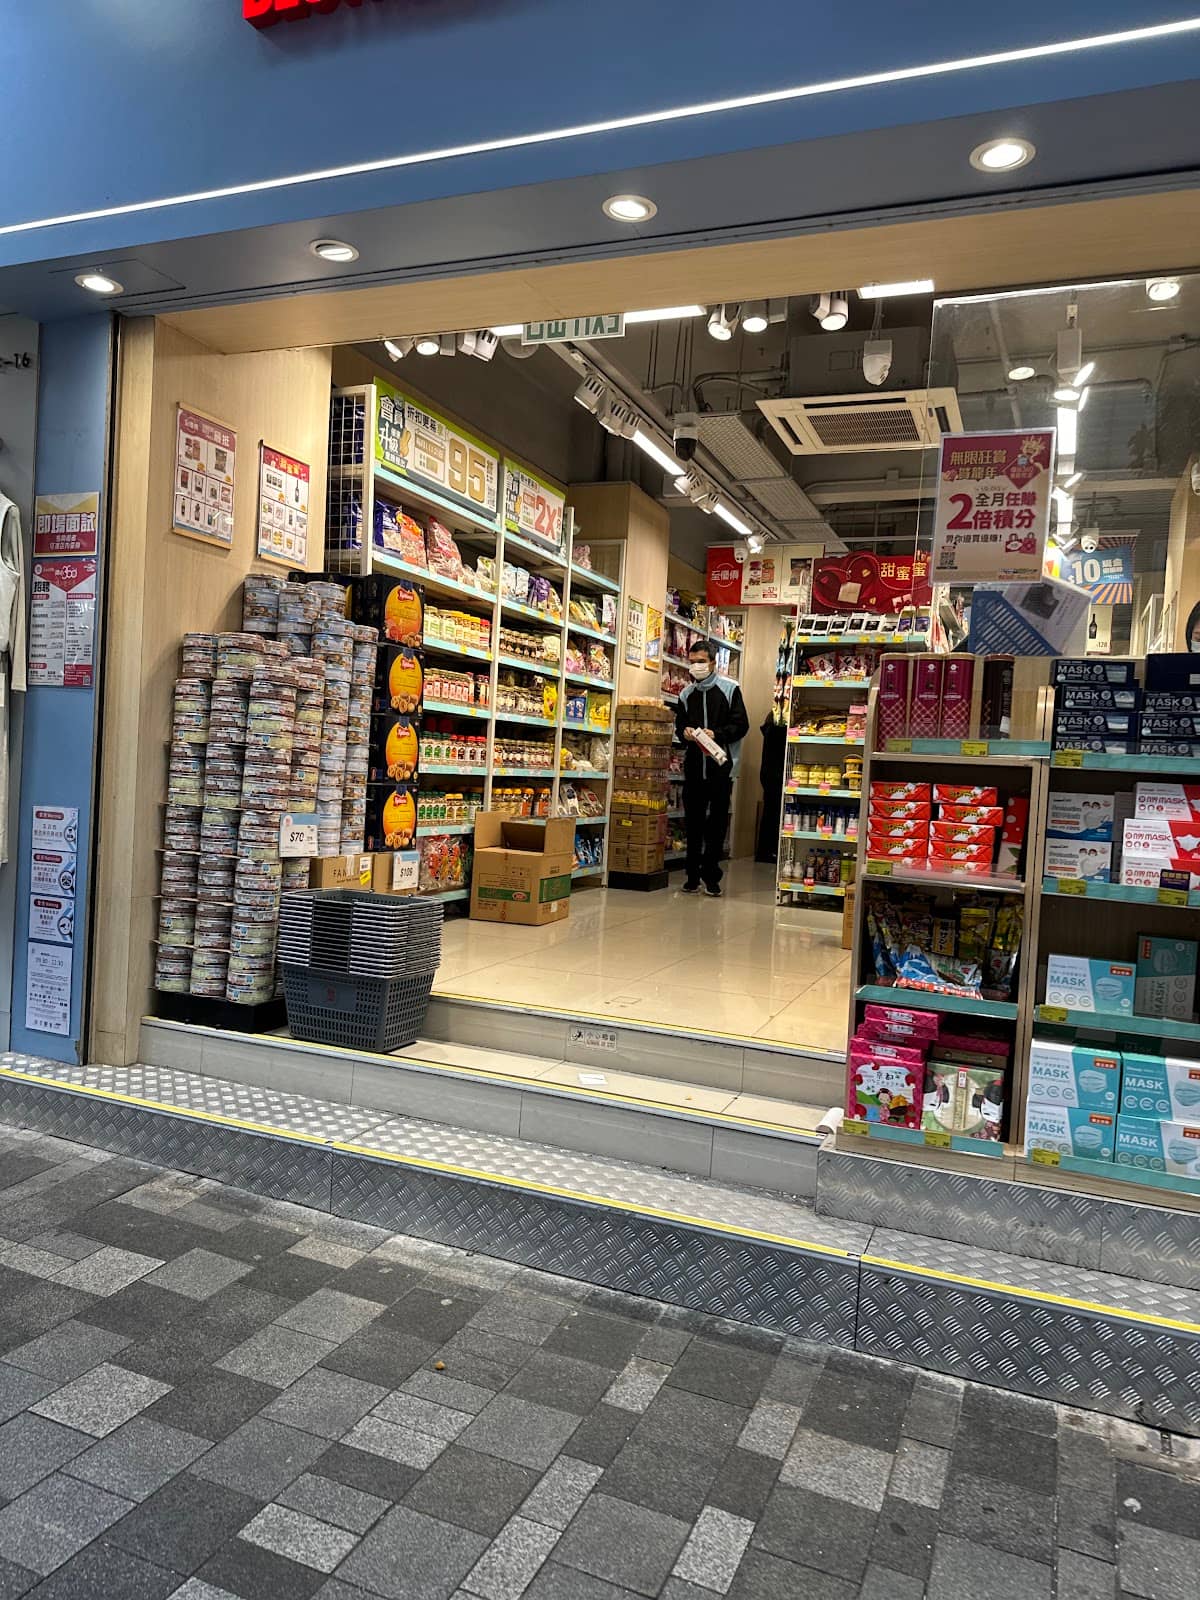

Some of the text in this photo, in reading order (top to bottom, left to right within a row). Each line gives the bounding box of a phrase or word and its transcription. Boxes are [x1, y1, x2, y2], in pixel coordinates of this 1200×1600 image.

[880, 562, 928, 581] 甜蜜蜜
[1057, 665, 1091, 674] MASK
[1065, 691, 1100, 700] MASK
[1145, 698, 1180, 706] MASK
[1057, 717, 1092, 725] MASK
[1142, 719, 1178, 727] MASK
[1055, 741, 1090, 750] MASK
[1140, 744, 1176, 753] MASK
[1050, 975, 1086, 987] MASK
[1032, 1066, 1070, 1080] MASK
[1125, 1077, 1163, 1091] MASK
[1029, 1121, 1065, 1135] MASK
[1119, 1133, 1158, 1148] MASK
